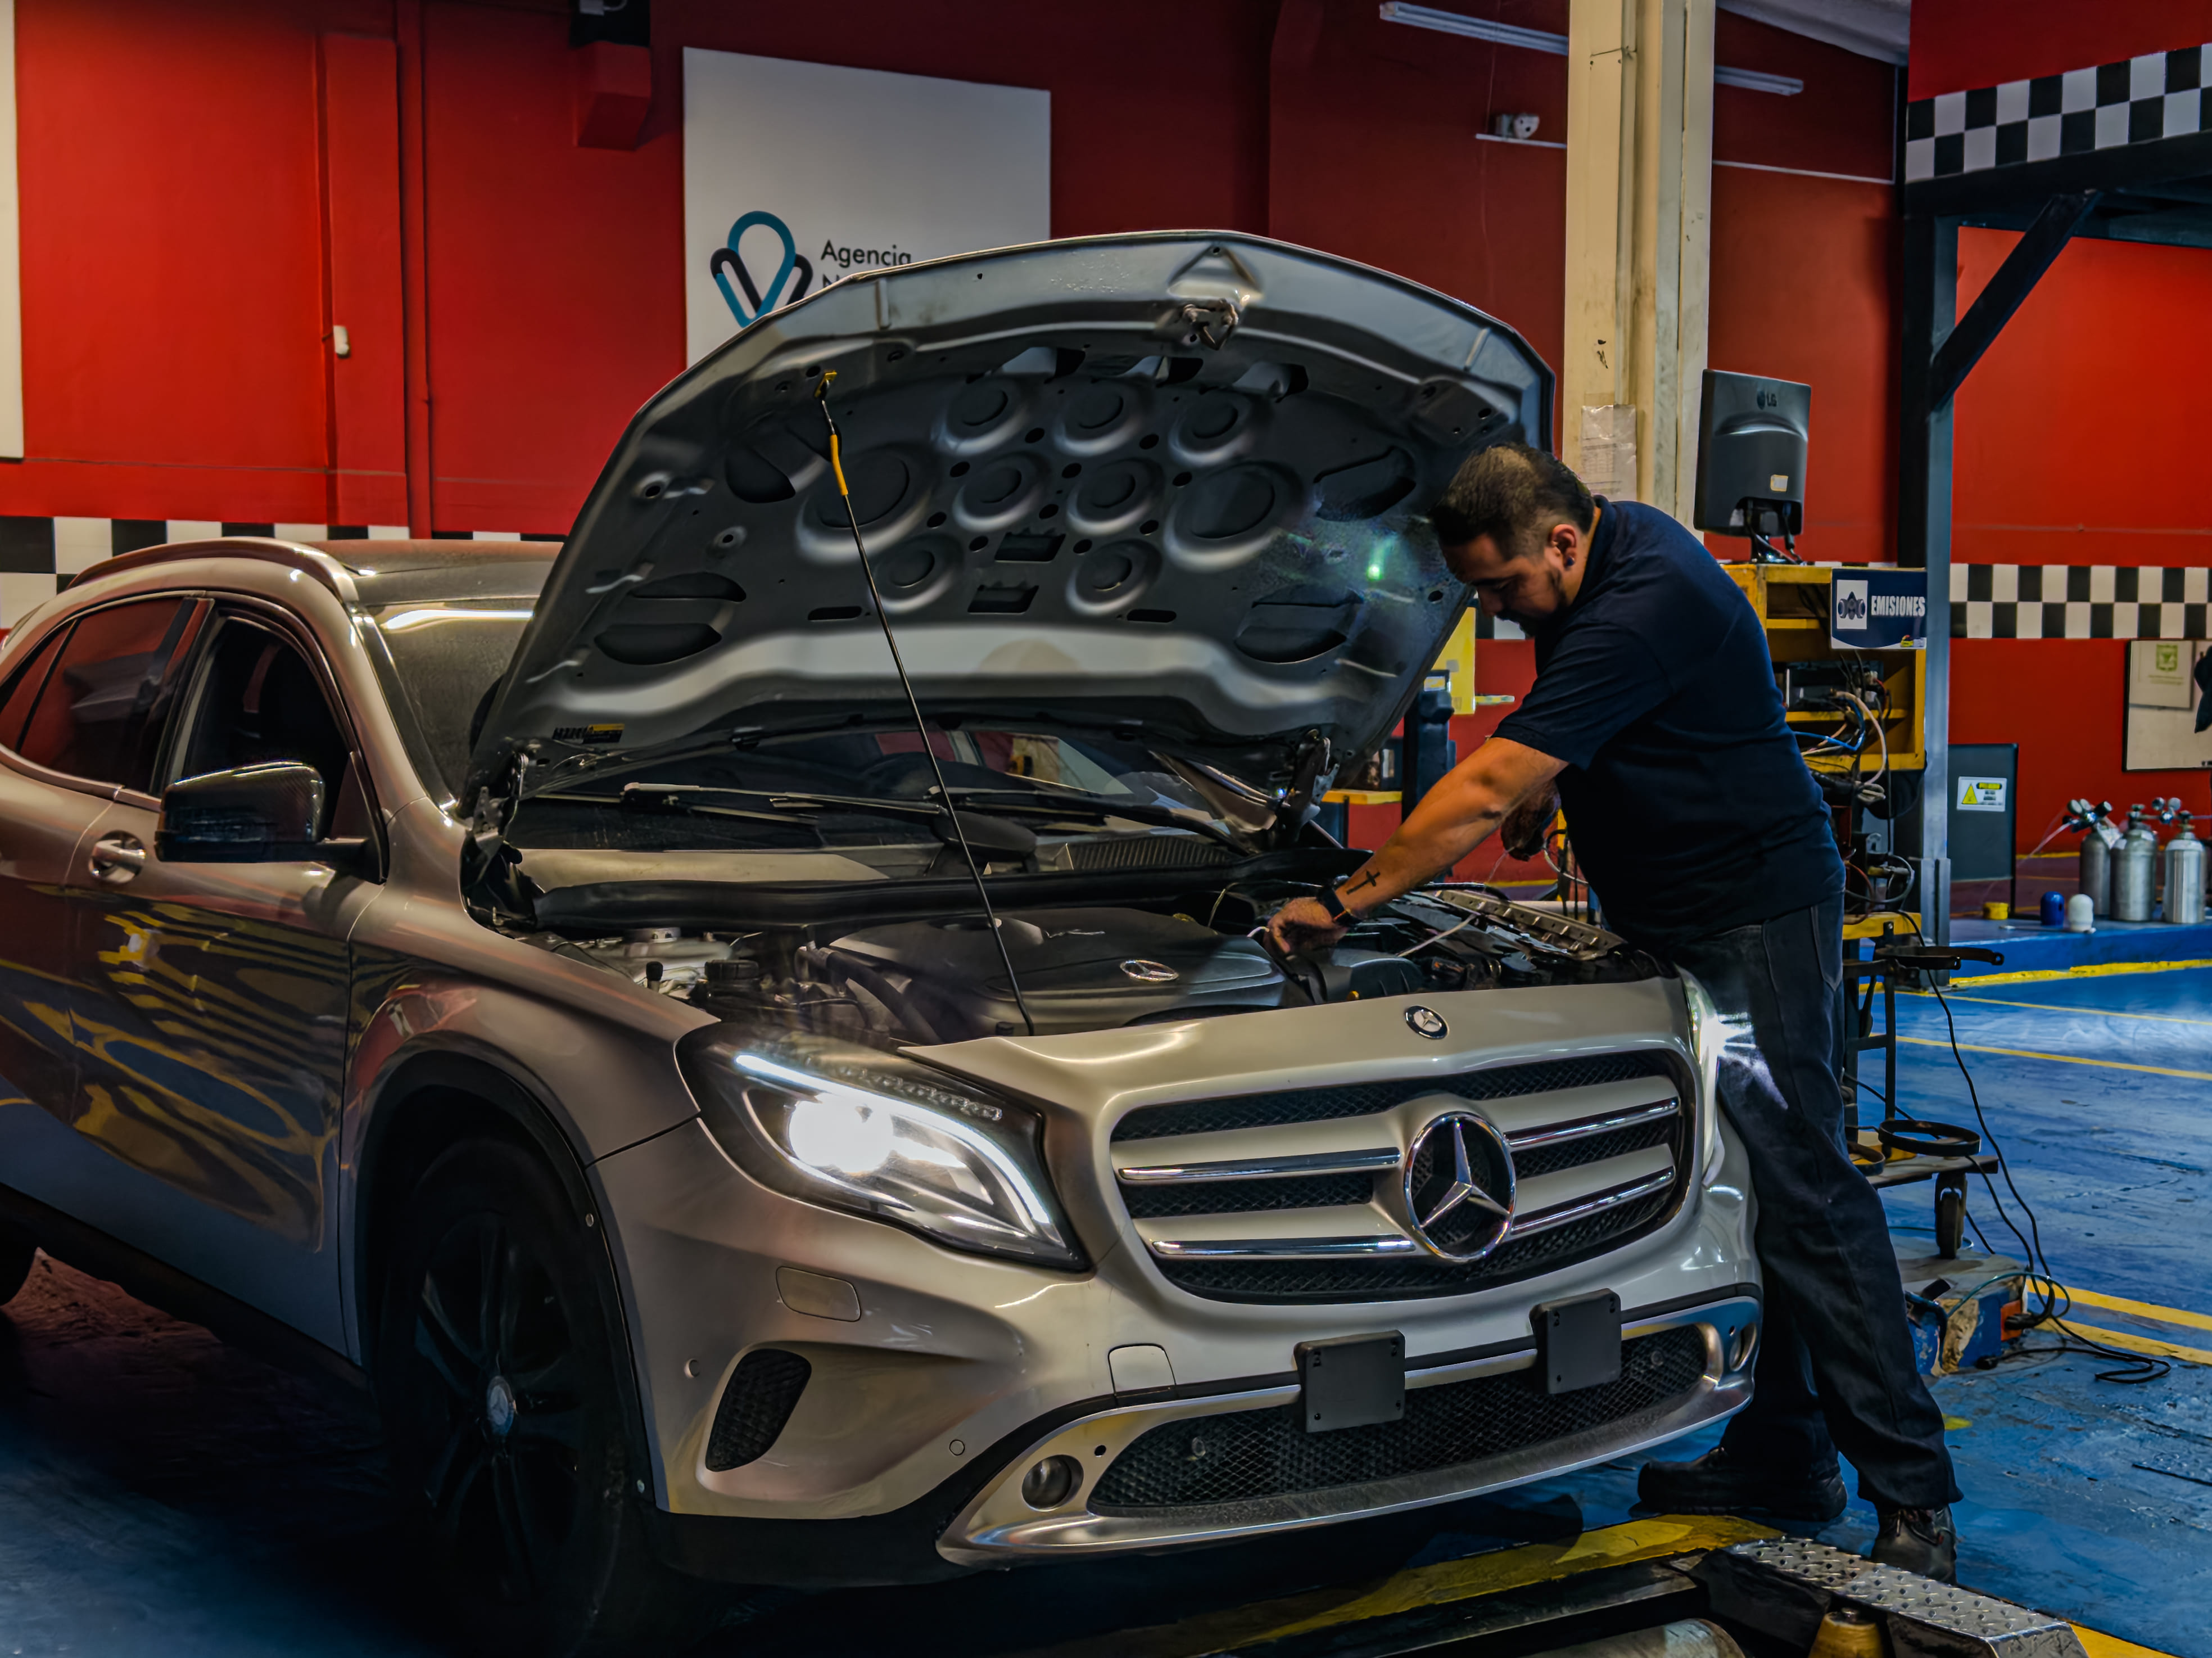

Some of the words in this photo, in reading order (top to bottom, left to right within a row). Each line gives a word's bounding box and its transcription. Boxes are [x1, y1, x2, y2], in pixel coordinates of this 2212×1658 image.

[821, 239, 911, 268] Agencia
[1766, 393, 1777, 407] LG
[1871, 595, 1925, 617] EMISIONES
